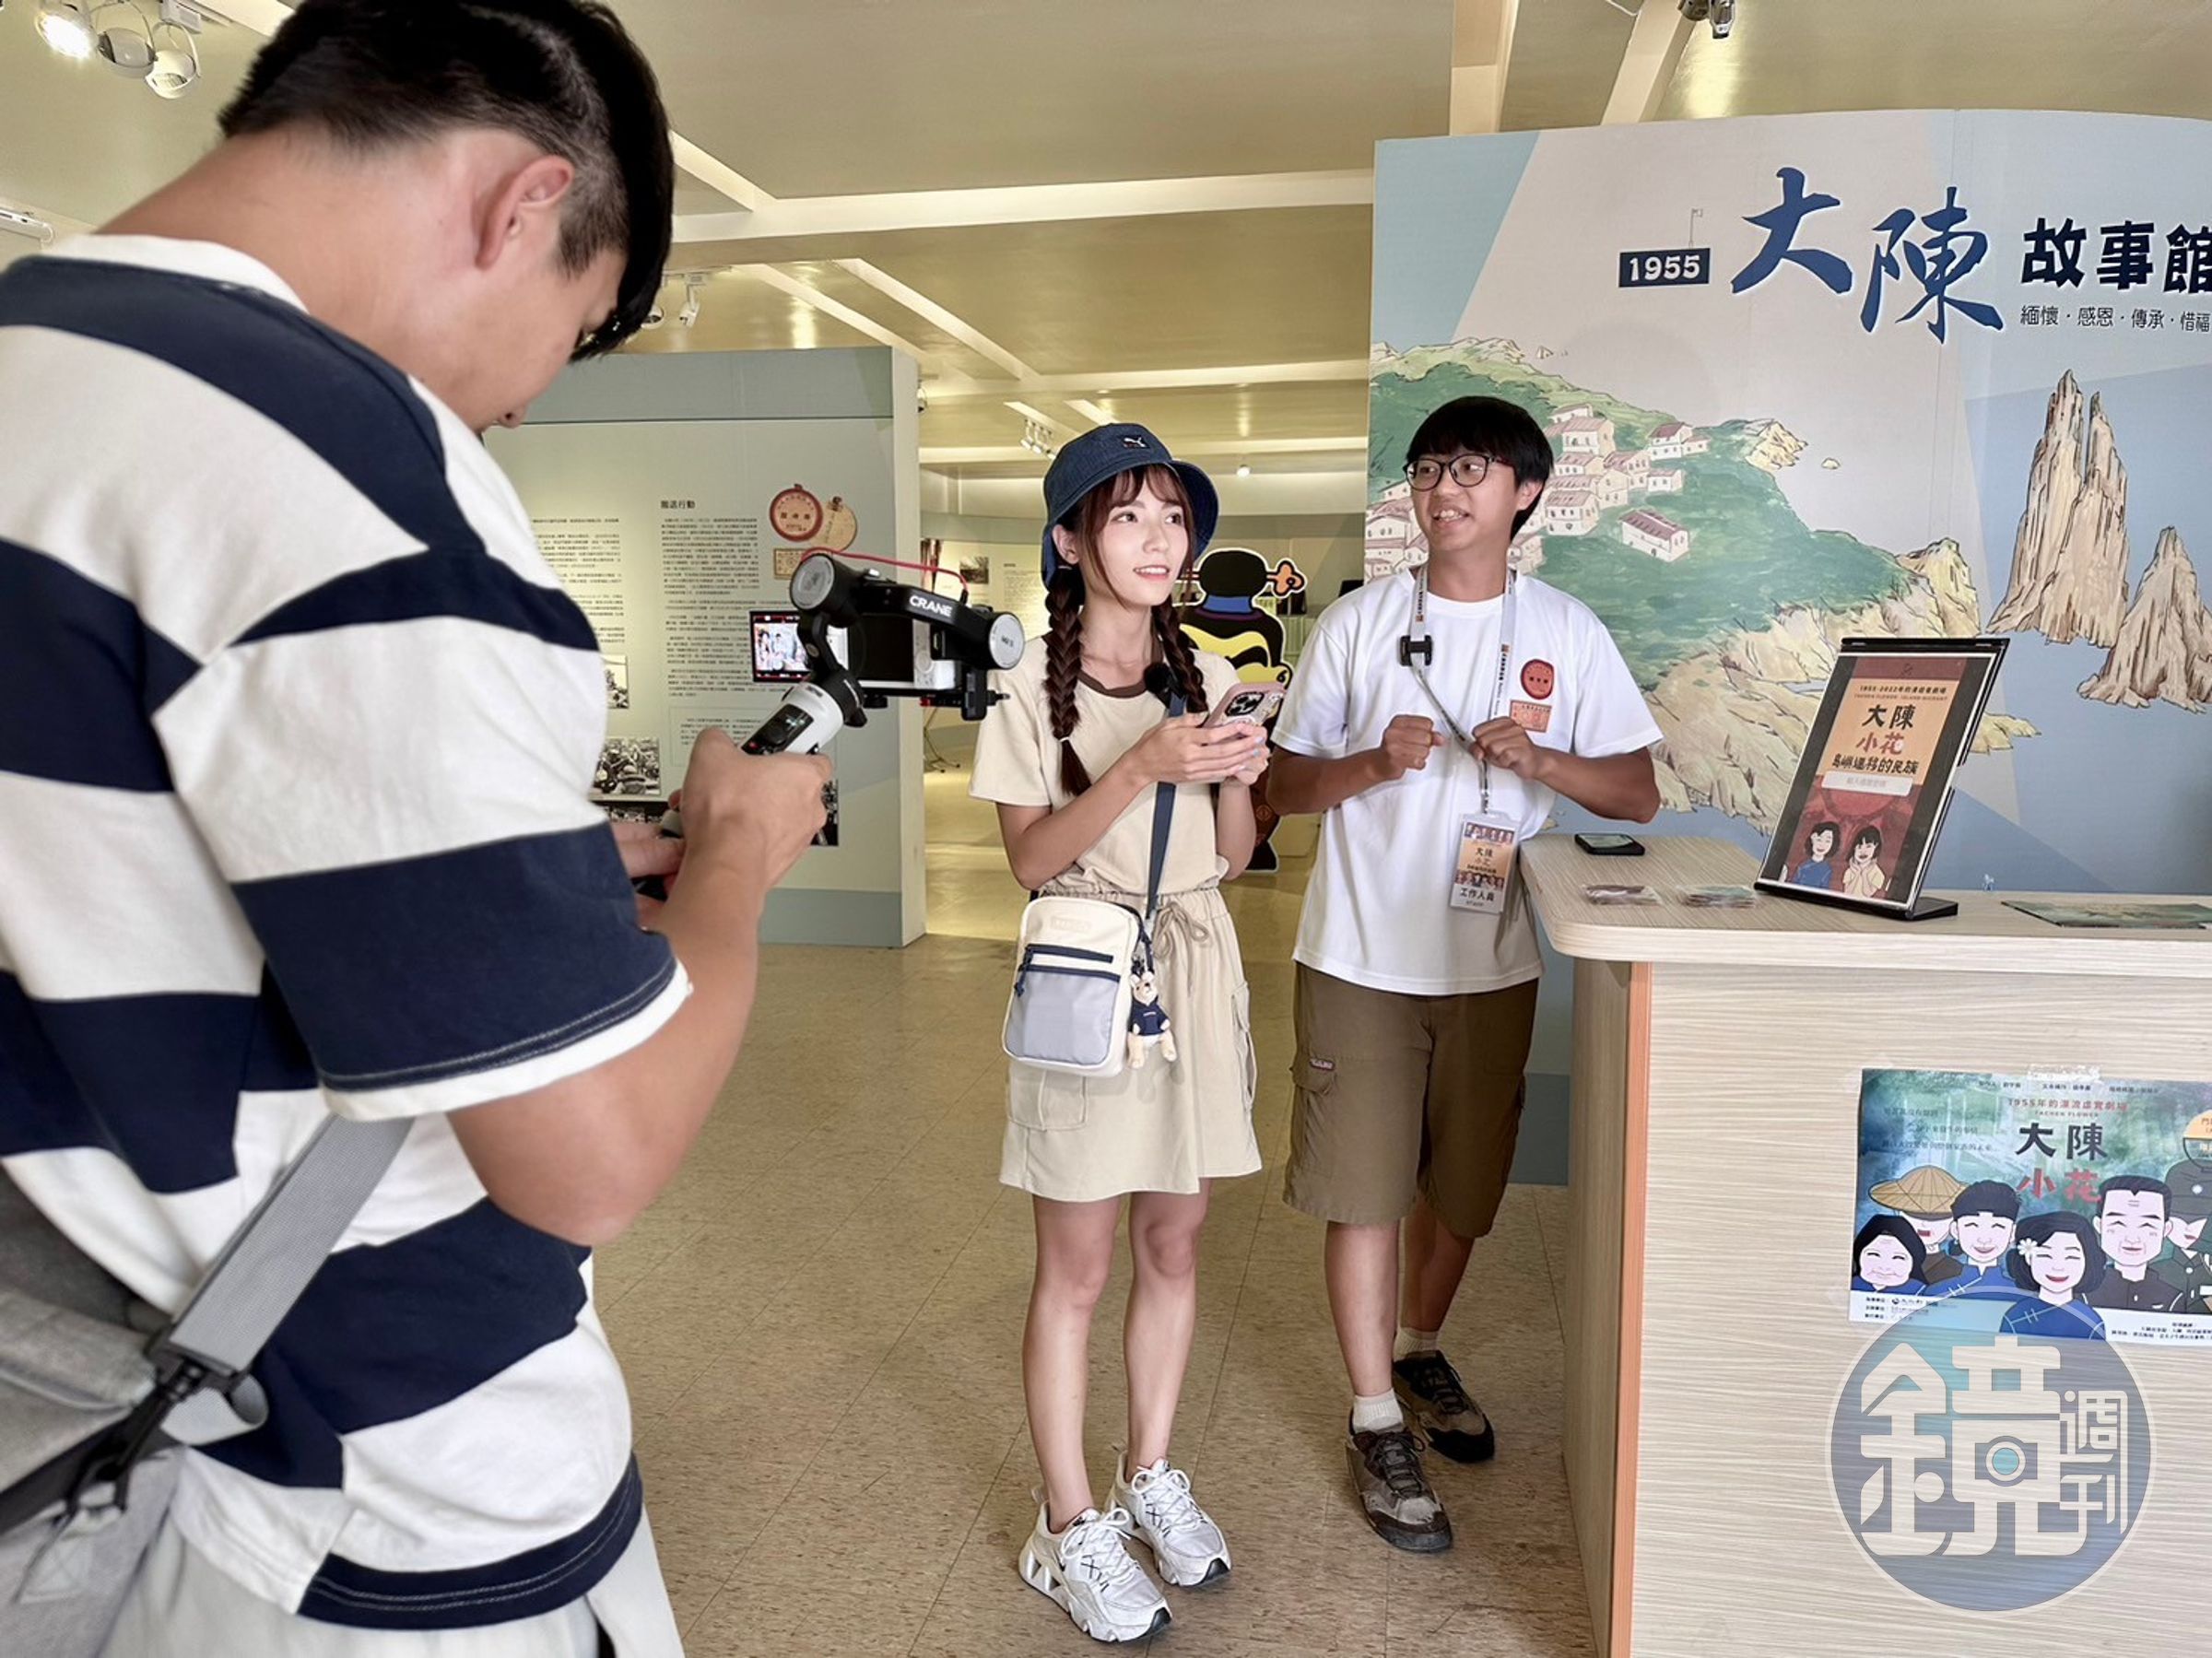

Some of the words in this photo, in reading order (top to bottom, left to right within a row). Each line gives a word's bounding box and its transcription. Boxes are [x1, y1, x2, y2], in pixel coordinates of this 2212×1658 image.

[1628, 254, 1701, 282] 1955
[1731, 167, 2003, 345] 大陳
[2021, 218, 2212, 293] 故事館
[909, 595, 954, 617] CRANE
[1862, 704, 1916, 730] 大陳
[1855, 732, 1904, 756] 小花
[1460, 888, 1495, 901] 工作人員
[2016, 1123, 2108, 1160] 大陳
[2017, 1168, 2102, 1203] 小花
